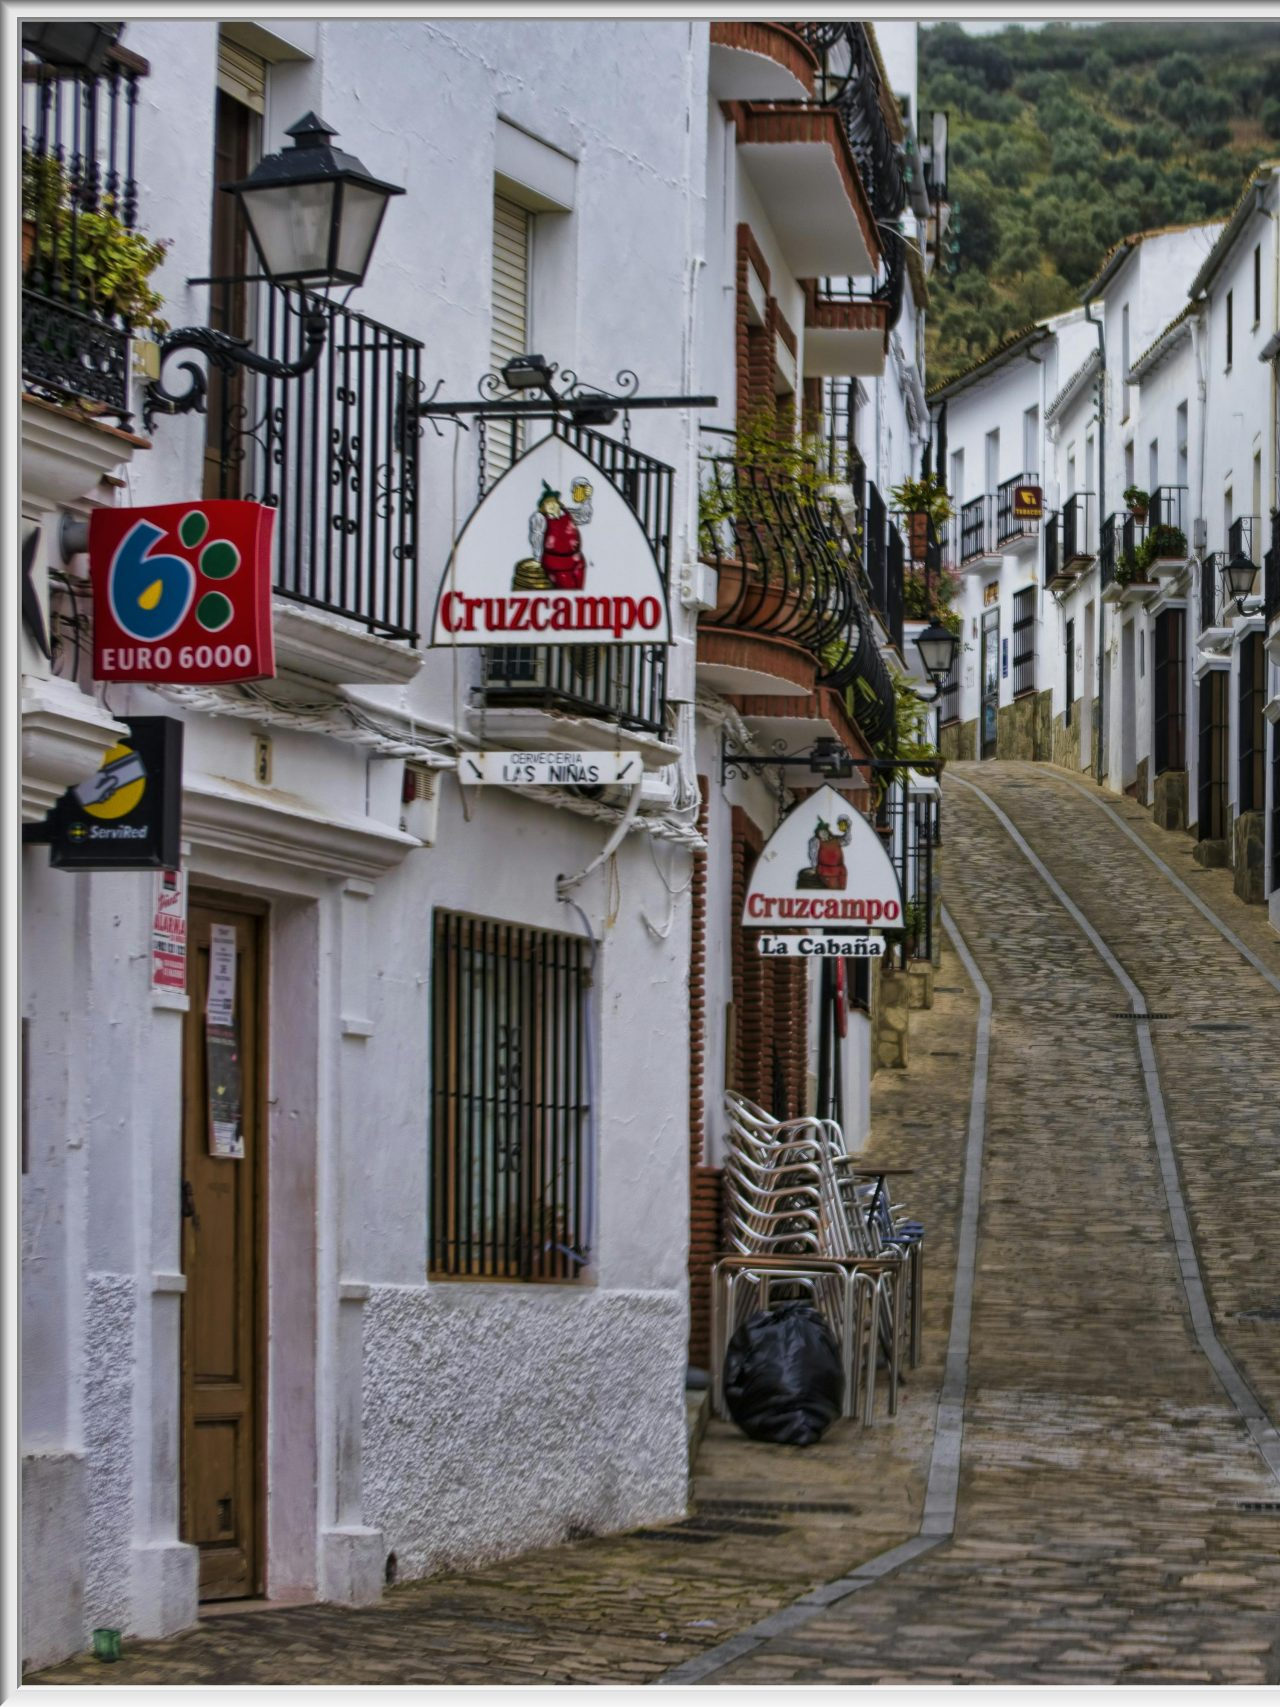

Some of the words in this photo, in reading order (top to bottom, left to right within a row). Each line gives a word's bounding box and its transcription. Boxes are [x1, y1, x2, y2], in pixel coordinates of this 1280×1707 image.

[441, 591, 662, 639] Cruzcampo
[102, 646, 172, 671] EURO
[178, 644, 252, 669] 6000
[510, 753, 583, 764] CERVECERIA
[502, 765, 536, 782] LAS
[549, 764, 599, 783] NIÑAS
[89, 824, 148, 839] ServiRed
[747, 893, 900, 925] Cruzcampo
[762, 937, 788, 955] La
[798, 937, 881, 955] Cabaña
